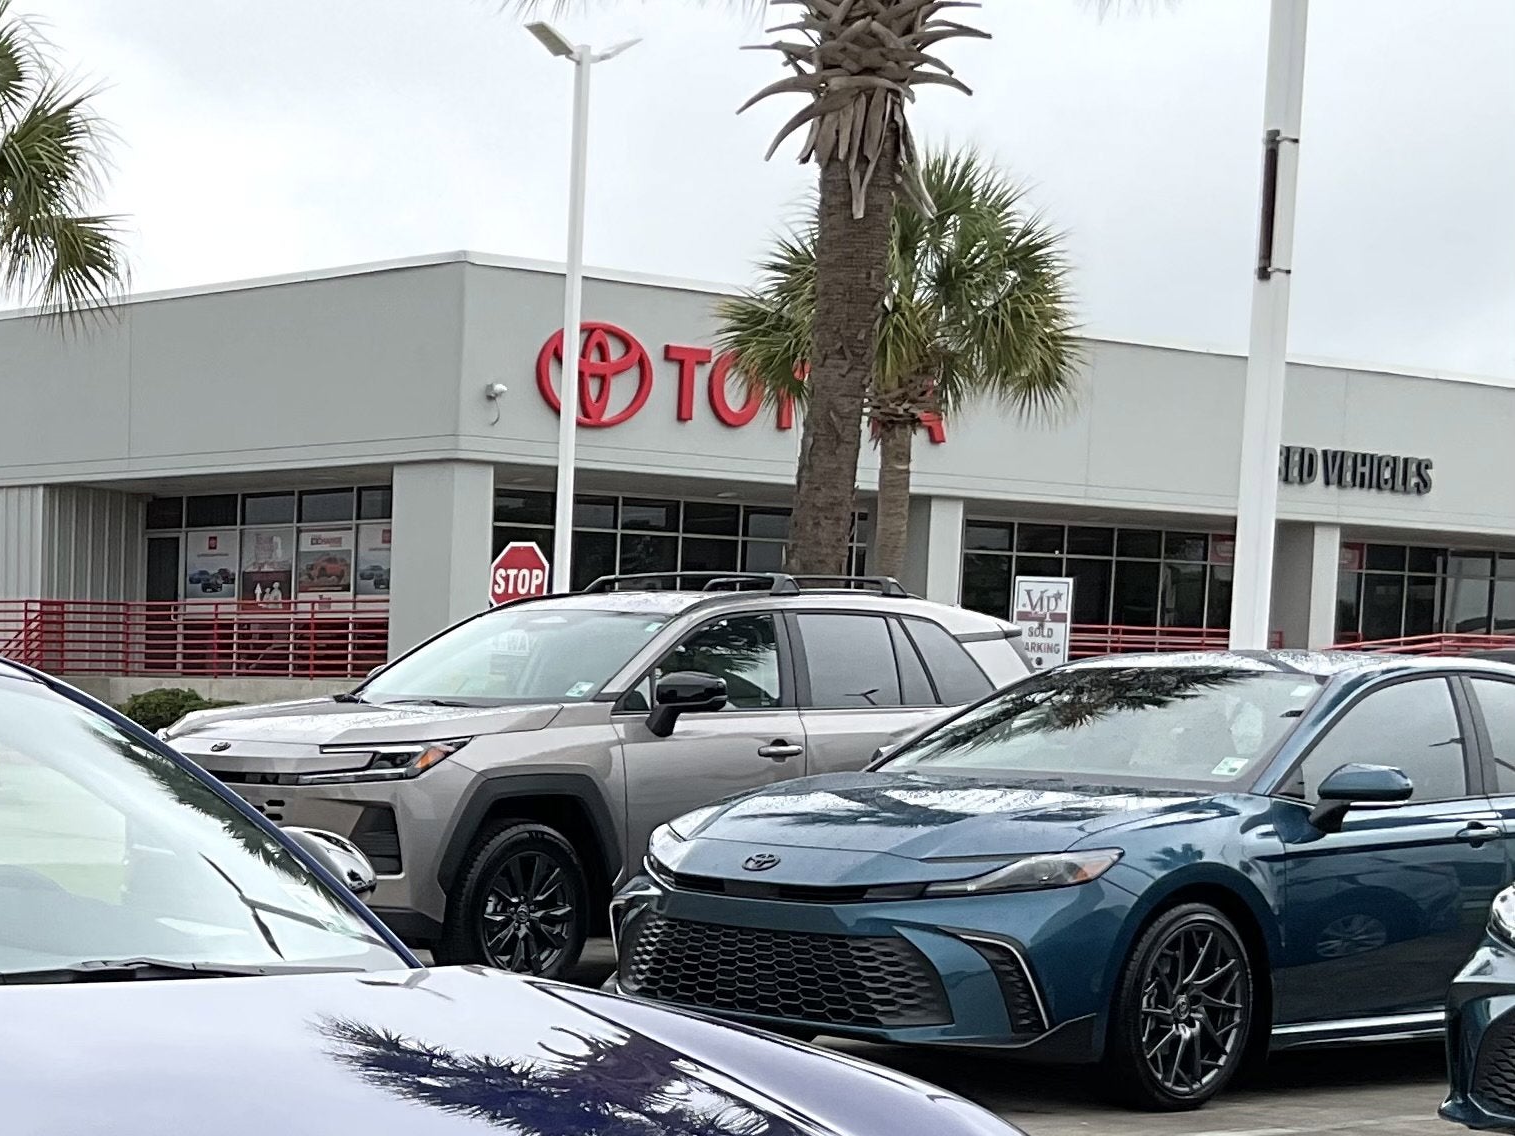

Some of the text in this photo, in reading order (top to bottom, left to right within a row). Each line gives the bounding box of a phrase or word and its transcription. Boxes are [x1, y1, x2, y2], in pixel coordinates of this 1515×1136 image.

[1322, 449, 1433, 495] VEHICLES
[494, 568, 544, 595] STOP
[1028, 626, 1053, 638] SOLD
[1025, 642, 1060, 654] ARKING
